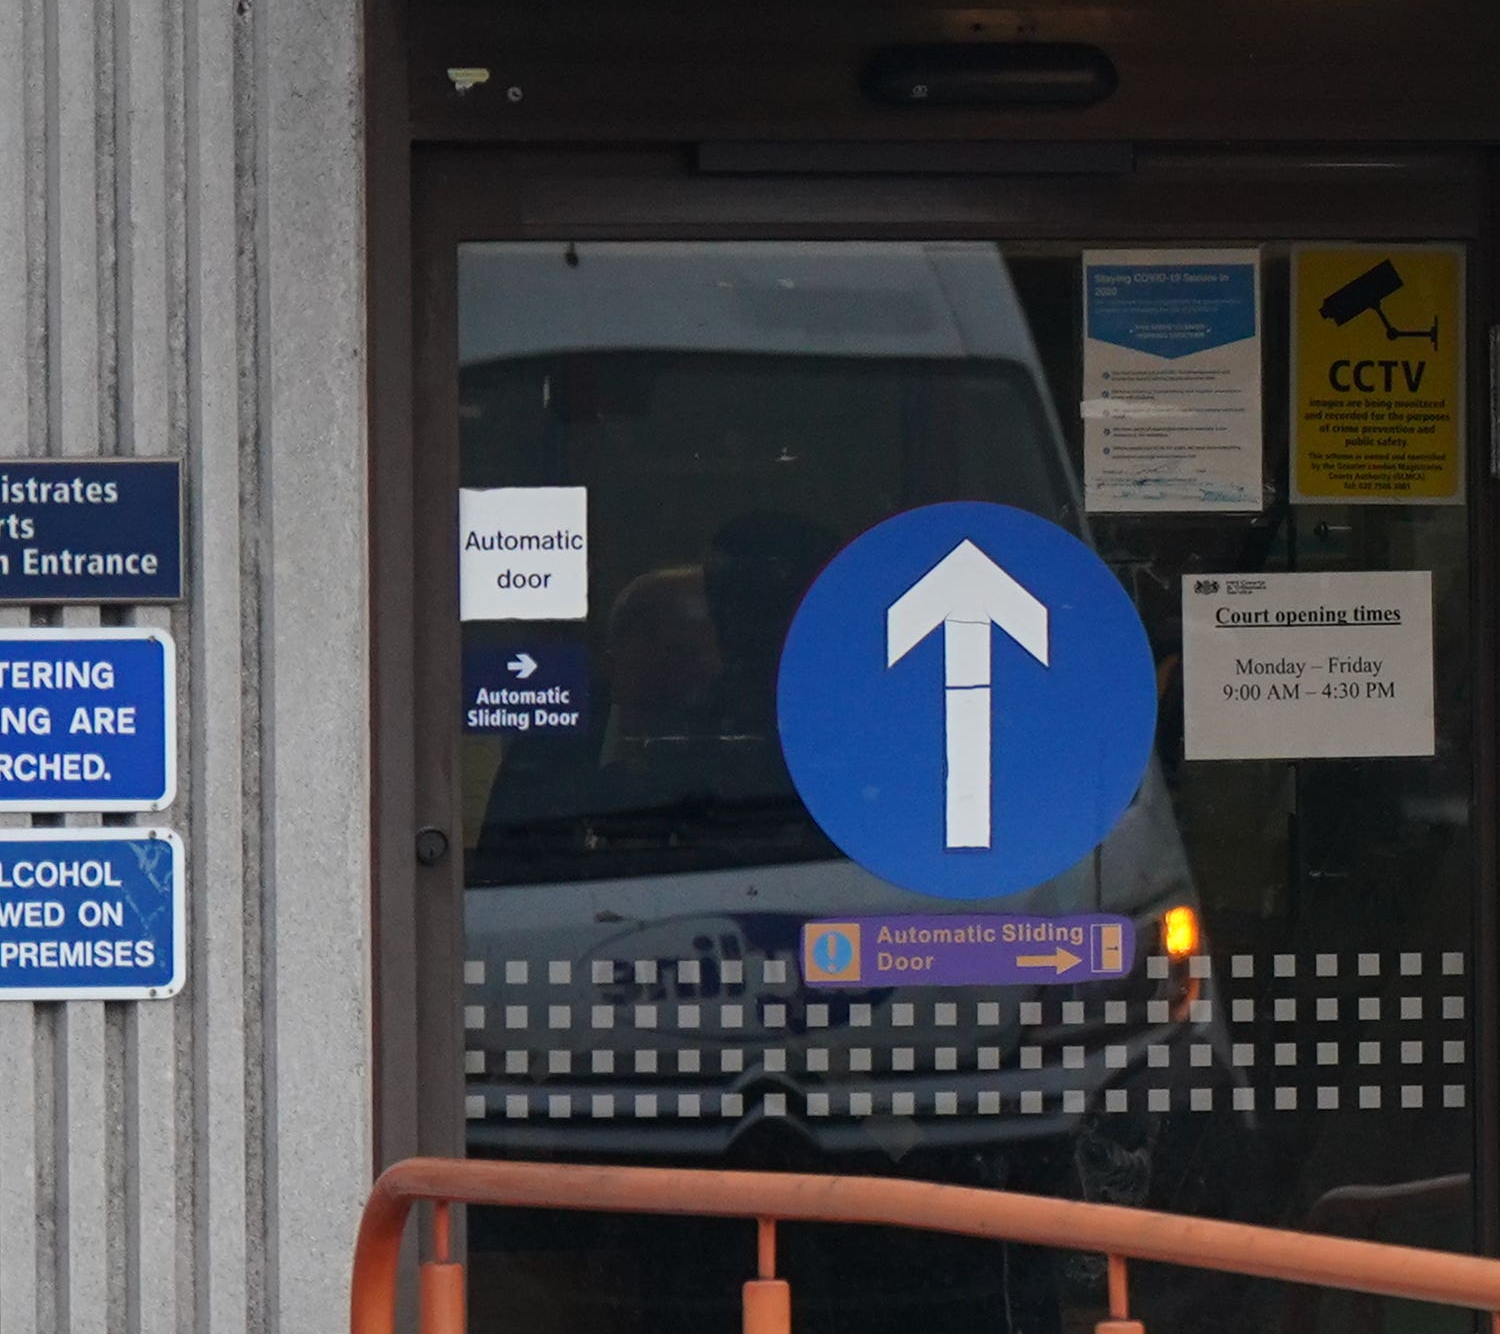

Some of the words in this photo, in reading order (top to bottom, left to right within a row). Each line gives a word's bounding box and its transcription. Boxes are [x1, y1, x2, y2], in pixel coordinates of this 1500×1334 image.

[1329, 359, 1427, 394] CCTV
[465, 530, 583, 551] Automatic
[23, 548, 158, 575] Entrance
[497, 568, 552, 590] door
[1215, 607, 1269, 622] Court
[1275, 606, 1347, 624] opening
[1353, 604, 1401, 622] times
[1235, 657, 1306, 679] Monday
[1329, 656, 1383, 678] Friday
[475, 686, 569, 705] Automatic
[1223, 684, 1261, 701] 9:00
[1267, 683, 1299, 700] AM
[1321, 682, 1360, 700] 4:30
[1366, 681, 1395, 698] PM
[69, 706, 136, 734] ARE
[467, 708, 530, 730] Sliding
[535, 709, 579, 726] Door
[77, 900, 123, 928] ON
[877, 924, 996, 944] Automatic
[1002, 922, 1083, 946] Sliding
[1, 940, 155, 968] PREMISES
[877, 952, 935, 972] Door
